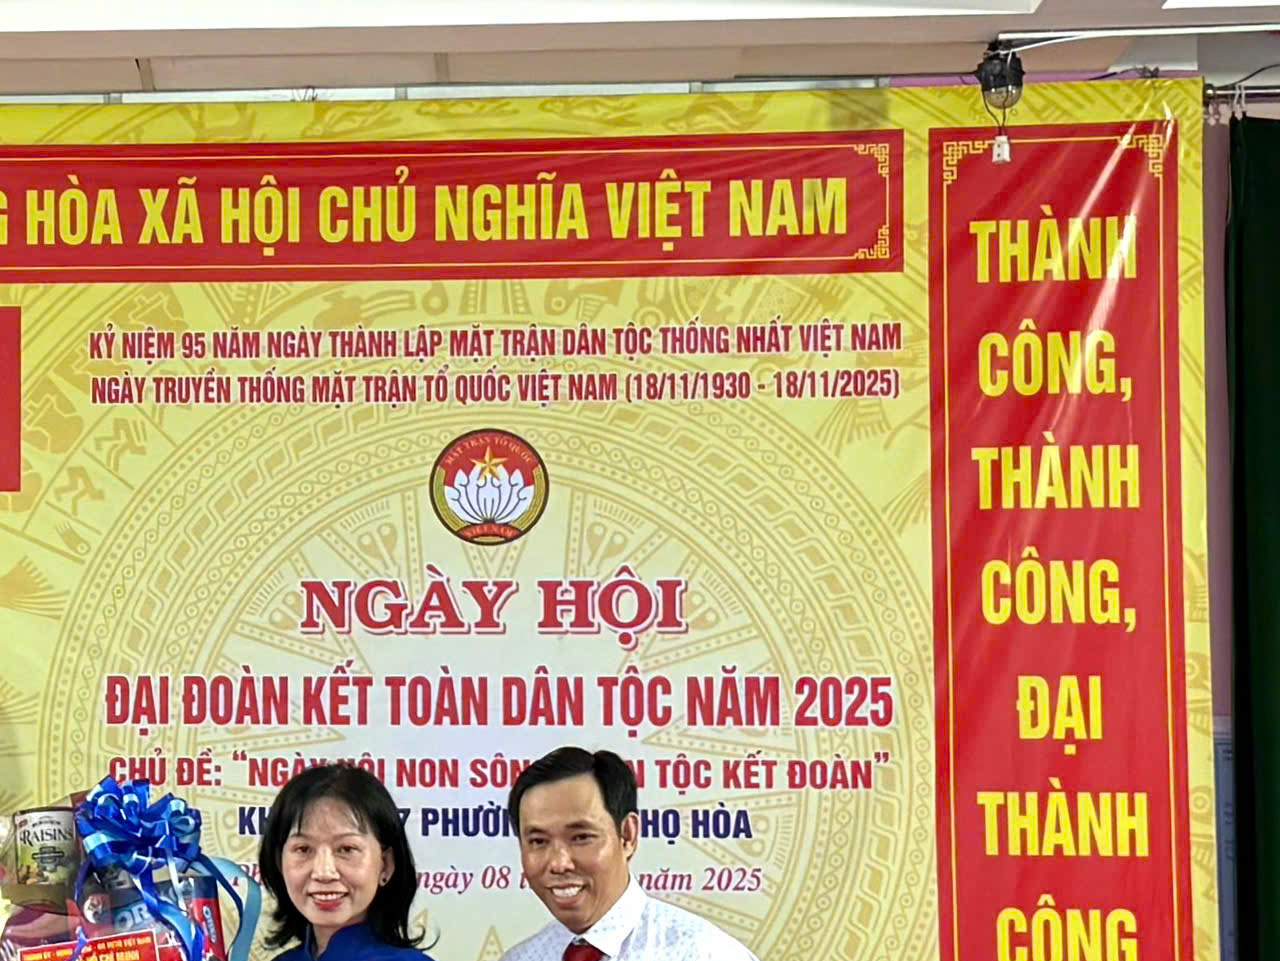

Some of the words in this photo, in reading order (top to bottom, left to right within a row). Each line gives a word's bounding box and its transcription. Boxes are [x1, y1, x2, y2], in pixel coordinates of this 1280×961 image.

[27, 175, 122, 246] HÒA
[140, 176, 205, 245] XÃ
[221, 174, 301, 257] HỘI
[318, 166, 417, 244] CHỦ
[436, 172, 590, 243] NGHĨA
[608, 170, 711, 251] VIỆT
[729, 177, 848, 238] NAM
[969, 205, 1137, 283] THÀNH
[89, 323, 115, 359] KỶ
[122, 326, 175, 365] NIỆM
[181, 333, 206, 359] 95
[212, 326, 260, 359] NĂM
[267, 325, 322, 359] NGÀY
[329, 325, 397, 358] THÀNH
[403, 325, 443, 363] LẬP
[449, 324, 495, 363] MẶT
[501, 323, 556, 361] TRẬN
[562, 323, 607, 356] DÂN
[613, 322, 653, 361] TỘC
[660, 316, 730, 355] THỐNG
[736, 315, 793, 354] NHẤT
[799, 319, 843, 357] VIỆT
[850, 322, 902, 352] NAM
[978, 319, 1133, 402] CÔNG,
[91, 371, 145, 404] NGÀY
[153, 367, 231, 404] TRUYỀN
[238, 366, 305, 404] THỐNG
[312, 370, 356, 409] MẶT
[363, 369, 417, 408] TRẬN
[424, 365, 449, 403] TỔ
[455, 365, 511, 404] QUỐC
[517, 369, 562, 407] VIỆT
[568, 373, 618, 401] NAM
[626, 372, 751, 402] (18/11/1930
[774, 369, 900, 398] 18/11/2025)
[971, 430, 1141, 510] THÀNH
[301, 564, 517, 635] NGÀY
[537, 564, 689, 652] HỘI
[980, 544, 1138, 633] CÔNG,
[105, 675, 169, 736] ĐẠI
[182, 665, 289, 726] ĐOÀN
[303, 660, 373, 726] KẾT
[385, 666, 489, 726] TOÀN
[502, 666, 584, 726] DÂN
[597, 665, 673, 738] TỘC
[687, 665, 780, 727] NĂM
[794, 676, 895, 728] 2025
[1014, 674, 1103, 756] ĐẠI
[176, 747, 222, 787] ĐỀ:
[396, 759, 459, 788] NON
[470, 753, 523, 788] SÔN
[655, 753, 712, 792] TỘC
[723, 750, 778, 789] KẾT
[421, 800, 519, 838] PHƯỜN
[641, 809, 681, 845] HỌ
[691, 801, 753, 839] HÒA
[977, 776, 1149, 857] THÀNH
[417, 865, 474, 895] ngày
[481, 865, 512, 890] 08
[701, 867, 762, 891] 2025
